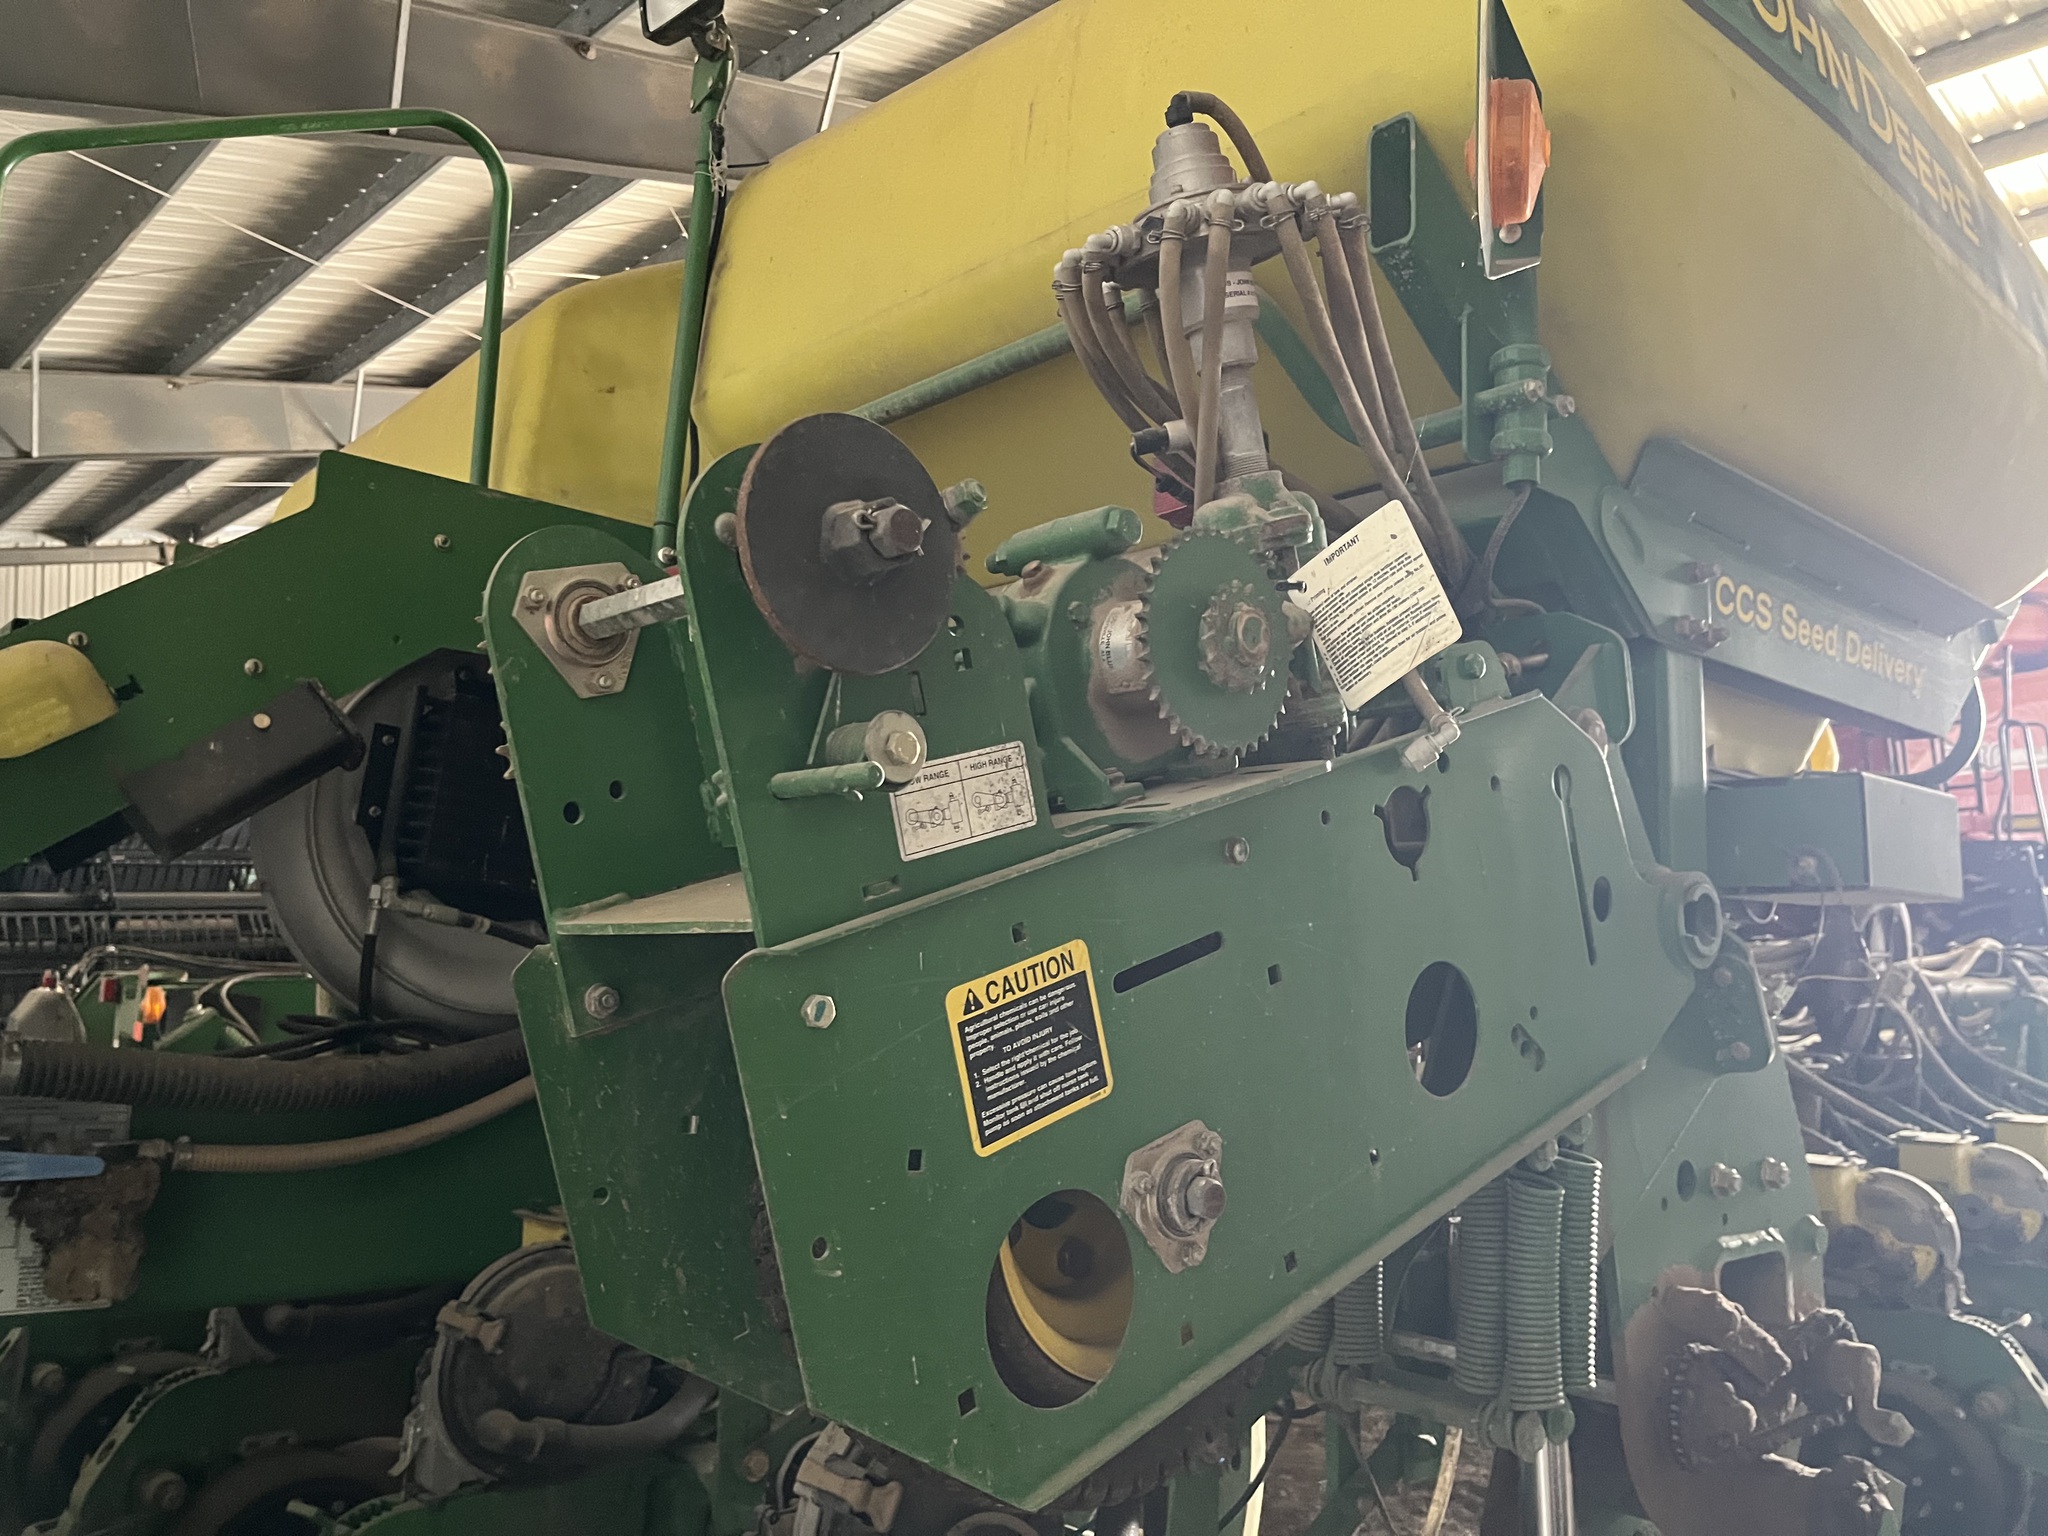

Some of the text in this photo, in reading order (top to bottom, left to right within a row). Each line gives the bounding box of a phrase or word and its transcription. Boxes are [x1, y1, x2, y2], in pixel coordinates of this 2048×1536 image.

[1753, 0, 1981, 247] OHN DEERE
[1323, 534, 1361, 566] IMPORTANT
[1715, 575, 1926, 688] CCS Seed Delivery
[969, 754, 1013, 772] HIGH RANGE
[923, 769, 950, 783] RANGE
[985, 950, 1075, 1004] CAUTION
[1028, 997, 1038, 1005] can
[1002, 1026, 1053, 1053] TO AVOID INJURY
[981, 1062, 1000, 1075] Select
[1000, 1057, 1010, 1066] the
[1050, 1036, 1058, 1044] for
[1059, 1031, 1068, 1040] the
[1039, 1060, 1046, 1068] by
[1047, 1055, 1056, 1063] the
[1004, 1064, 1015, 1074] and
[1036, 1082, 1047, 1091] can
